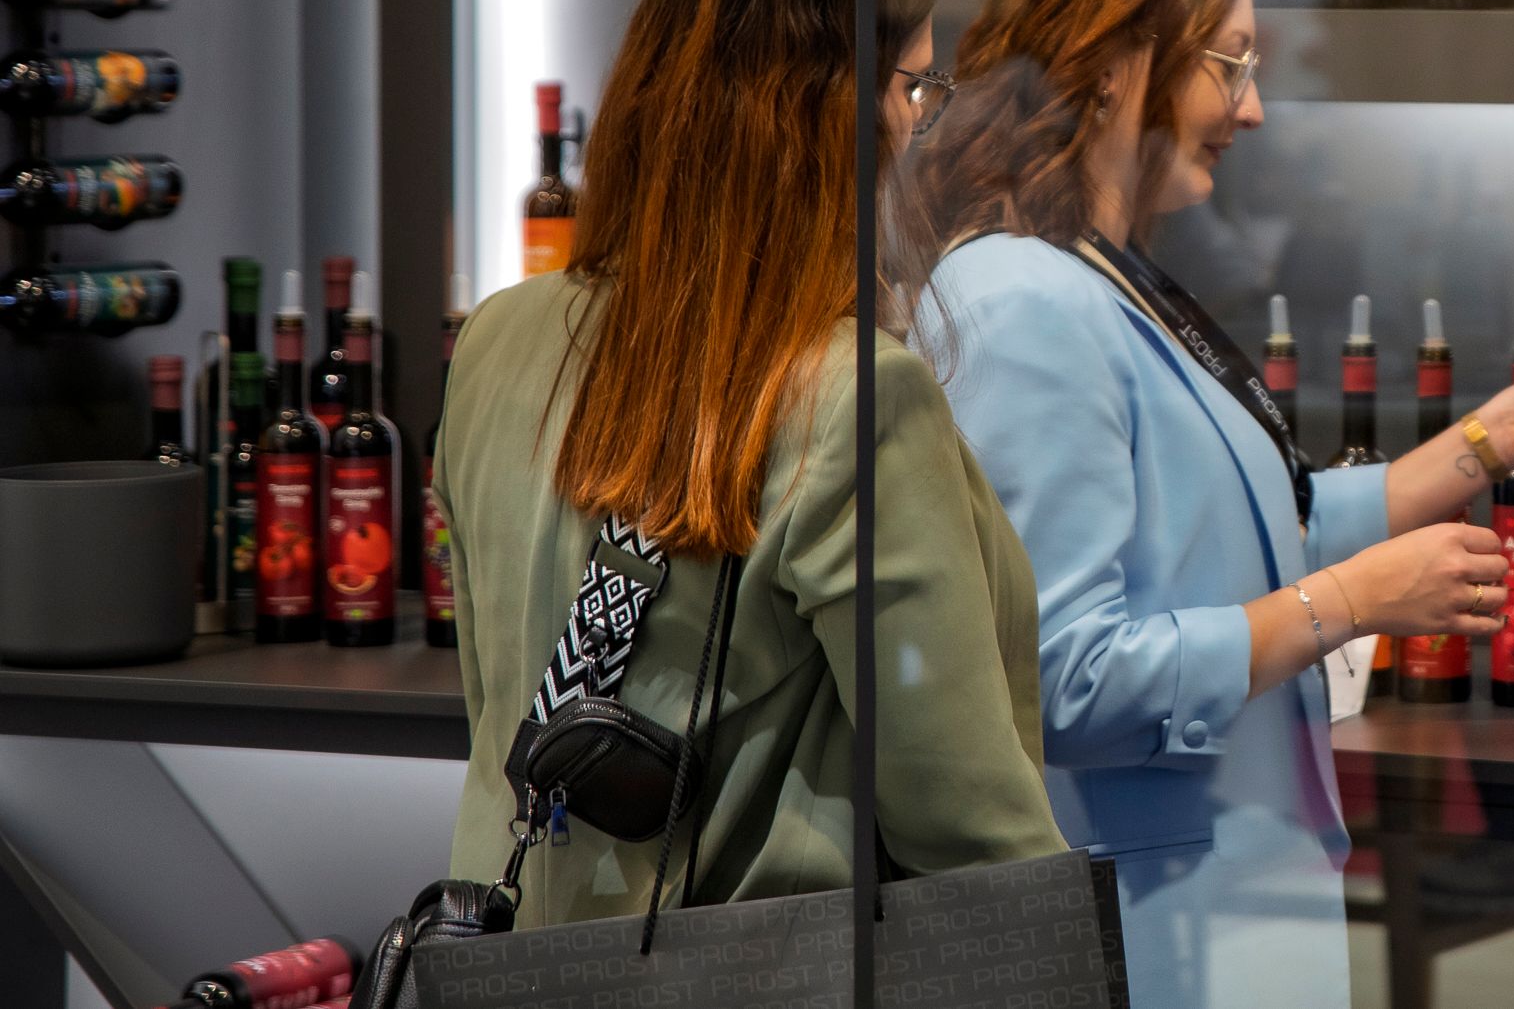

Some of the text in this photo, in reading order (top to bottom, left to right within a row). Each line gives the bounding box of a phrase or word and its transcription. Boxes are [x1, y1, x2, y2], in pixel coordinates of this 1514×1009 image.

[1178, 323, 1227, 377] PROST
[1246, 377, 1290, 432] PROST
[527, 924, 636, 958] PROST
[762, 895, 853, 928] PROS
[988, 855, 1086, 891] PROST
[439, 968, 546, 1005] PROST
[677, 937, 782, 970] PROST
[906, 901, 1010, 938] PROST
[592, 980, 699, 1009] PROST
[710, 964, 816, 998] PROST
[939, 926, 1043, 965] PROST
[973, 953, 1076, 991] PROST
